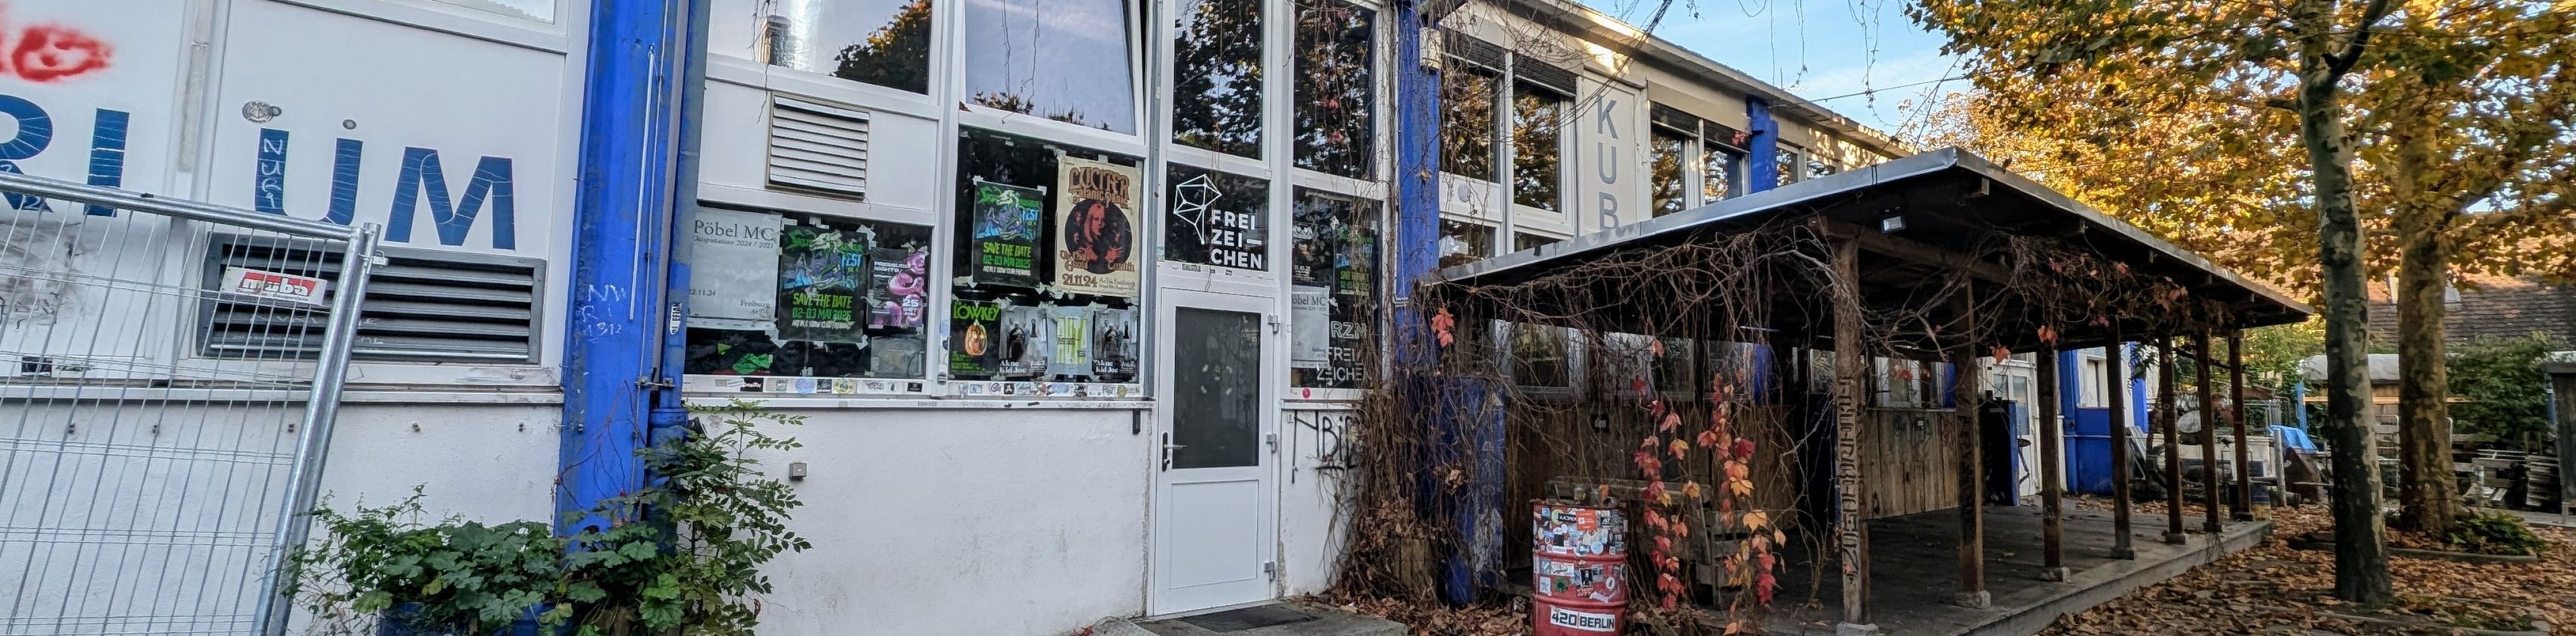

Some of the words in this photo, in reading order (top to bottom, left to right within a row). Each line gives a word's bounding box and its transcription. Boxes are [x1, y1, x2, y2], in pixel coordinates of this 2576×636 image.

[1598, 94, 1618, 231] KUB
[1211, 209, 1255, 230] FREI
[694, 220, 739, 237] Pöbel
[743, 226, 775, 242] MC
[983, 242, 1000, 254] SAVE
[1002, 244, 1014, 256] THE
[1015, 246, 1031, 257] DATE
[1211, 248, 1261, 269] CHEN
[740, 300, 770, 309] Freiburg
[832, 295, 852, 308] DATE
[1311, 295, 1327, 306] MC
[792, 307, 817, 319] 02-03
[818, 309, 832, 320] MAI
[1552, 611, 1577, 626] 420
[1580, 616, 1615, 629] BERLIN
